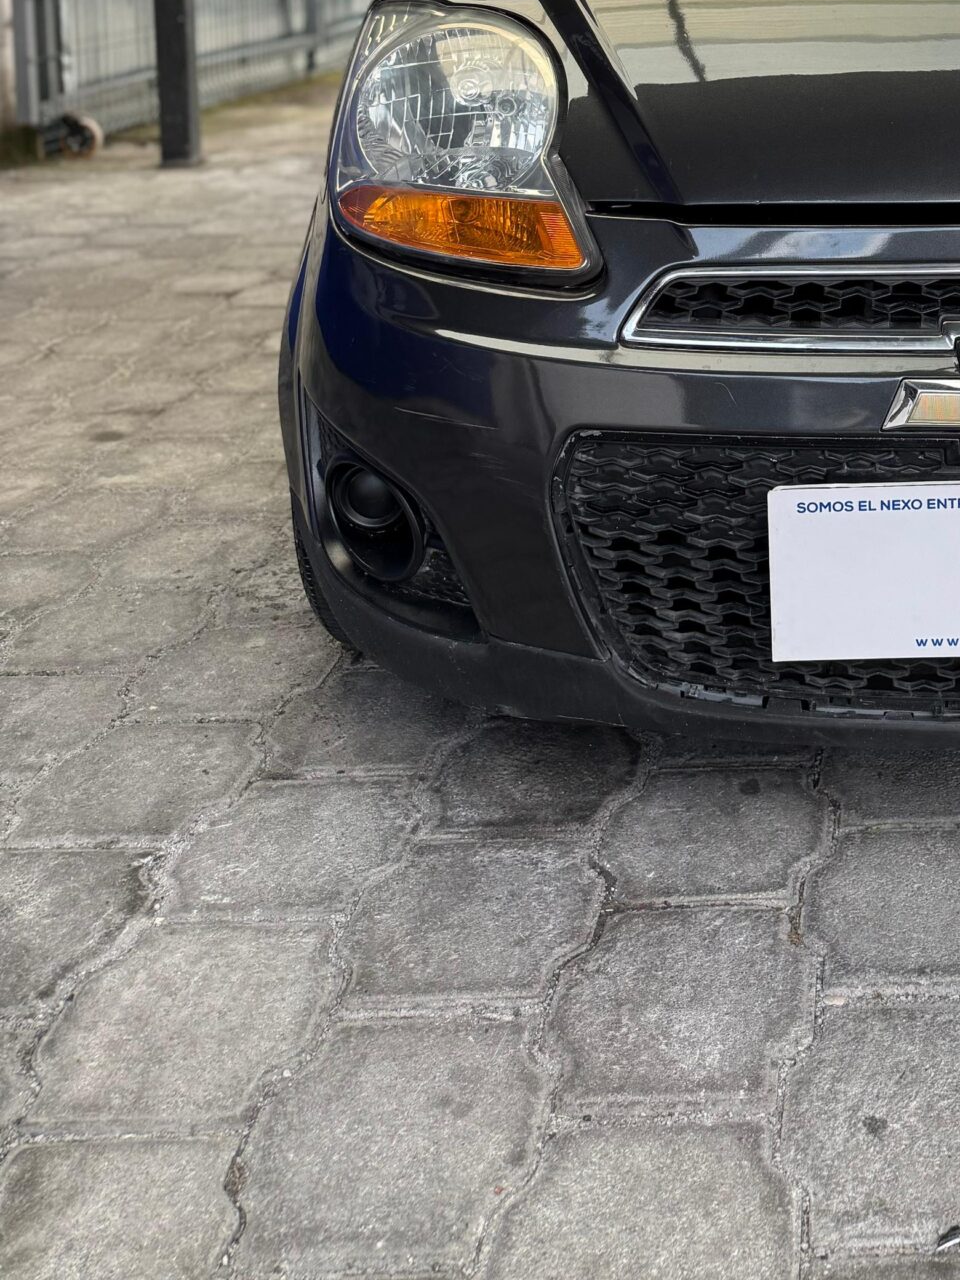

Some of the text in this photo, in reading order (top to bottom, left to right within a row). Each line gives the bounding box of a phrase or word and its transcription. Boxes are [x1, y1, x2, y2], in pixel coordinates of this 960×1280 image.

[796, 500, 854, 514] SOMOS
[858, 500, 877, 512] EL
[880, 498, 923, 511] NEXO
